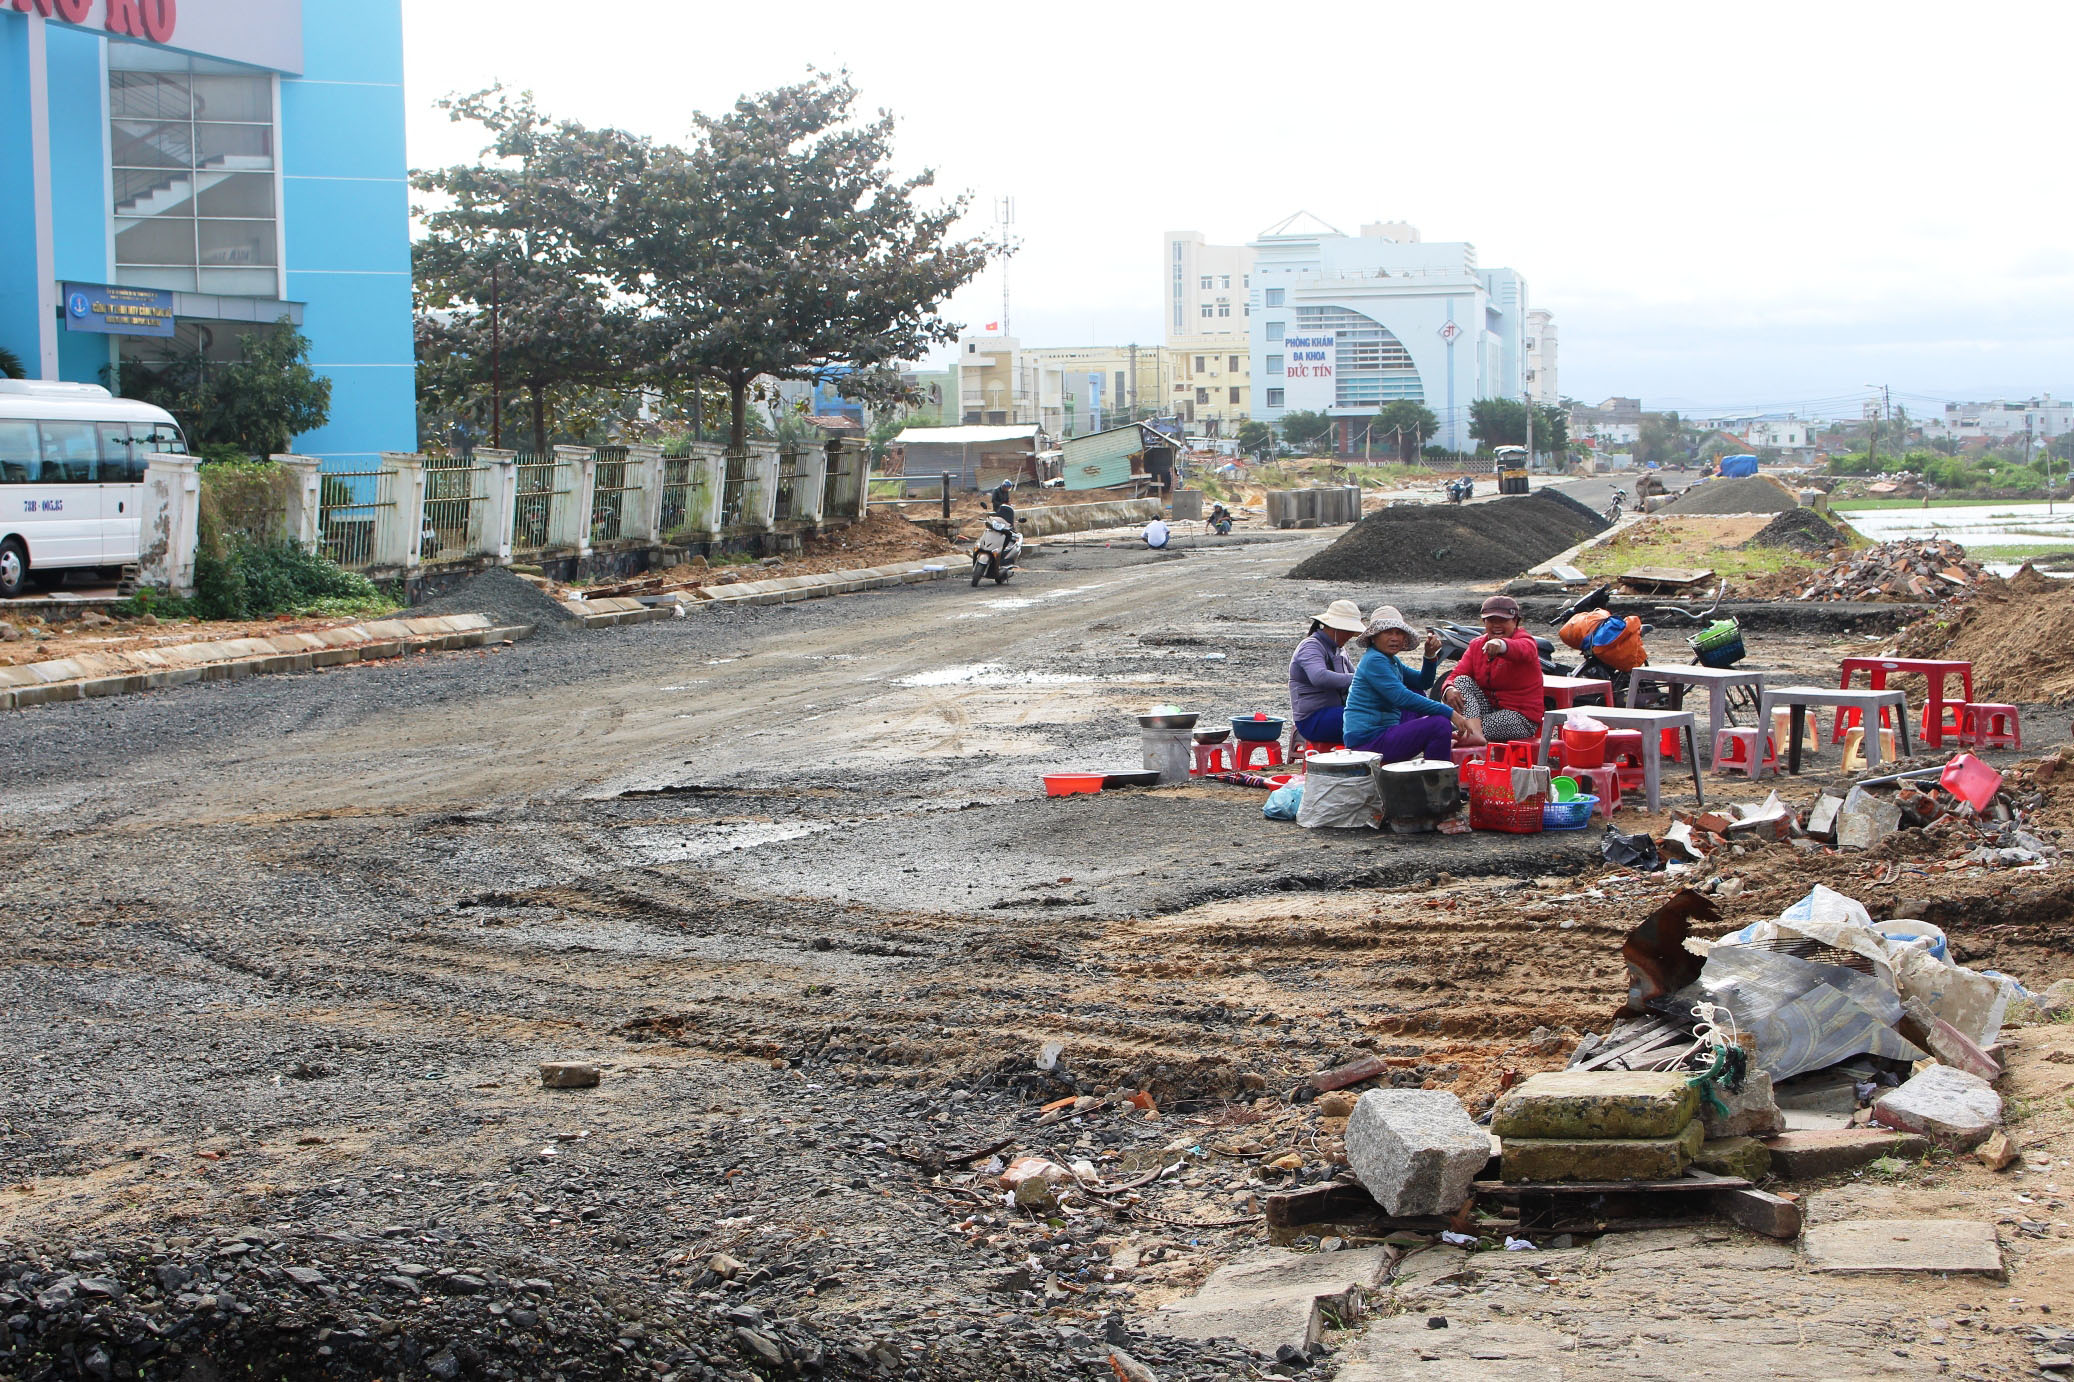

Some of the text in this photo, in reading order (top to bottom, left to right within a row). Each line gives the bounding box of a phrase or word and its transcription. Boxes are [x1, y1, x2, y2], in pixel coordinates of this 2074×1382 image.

[1285, 335, 1334, 348] PHÒNG KHÁM
[1293, 351, 1326, 361] ĐA KHOA
[1287, 362, 1332, 377] ĐỨC TÍN
